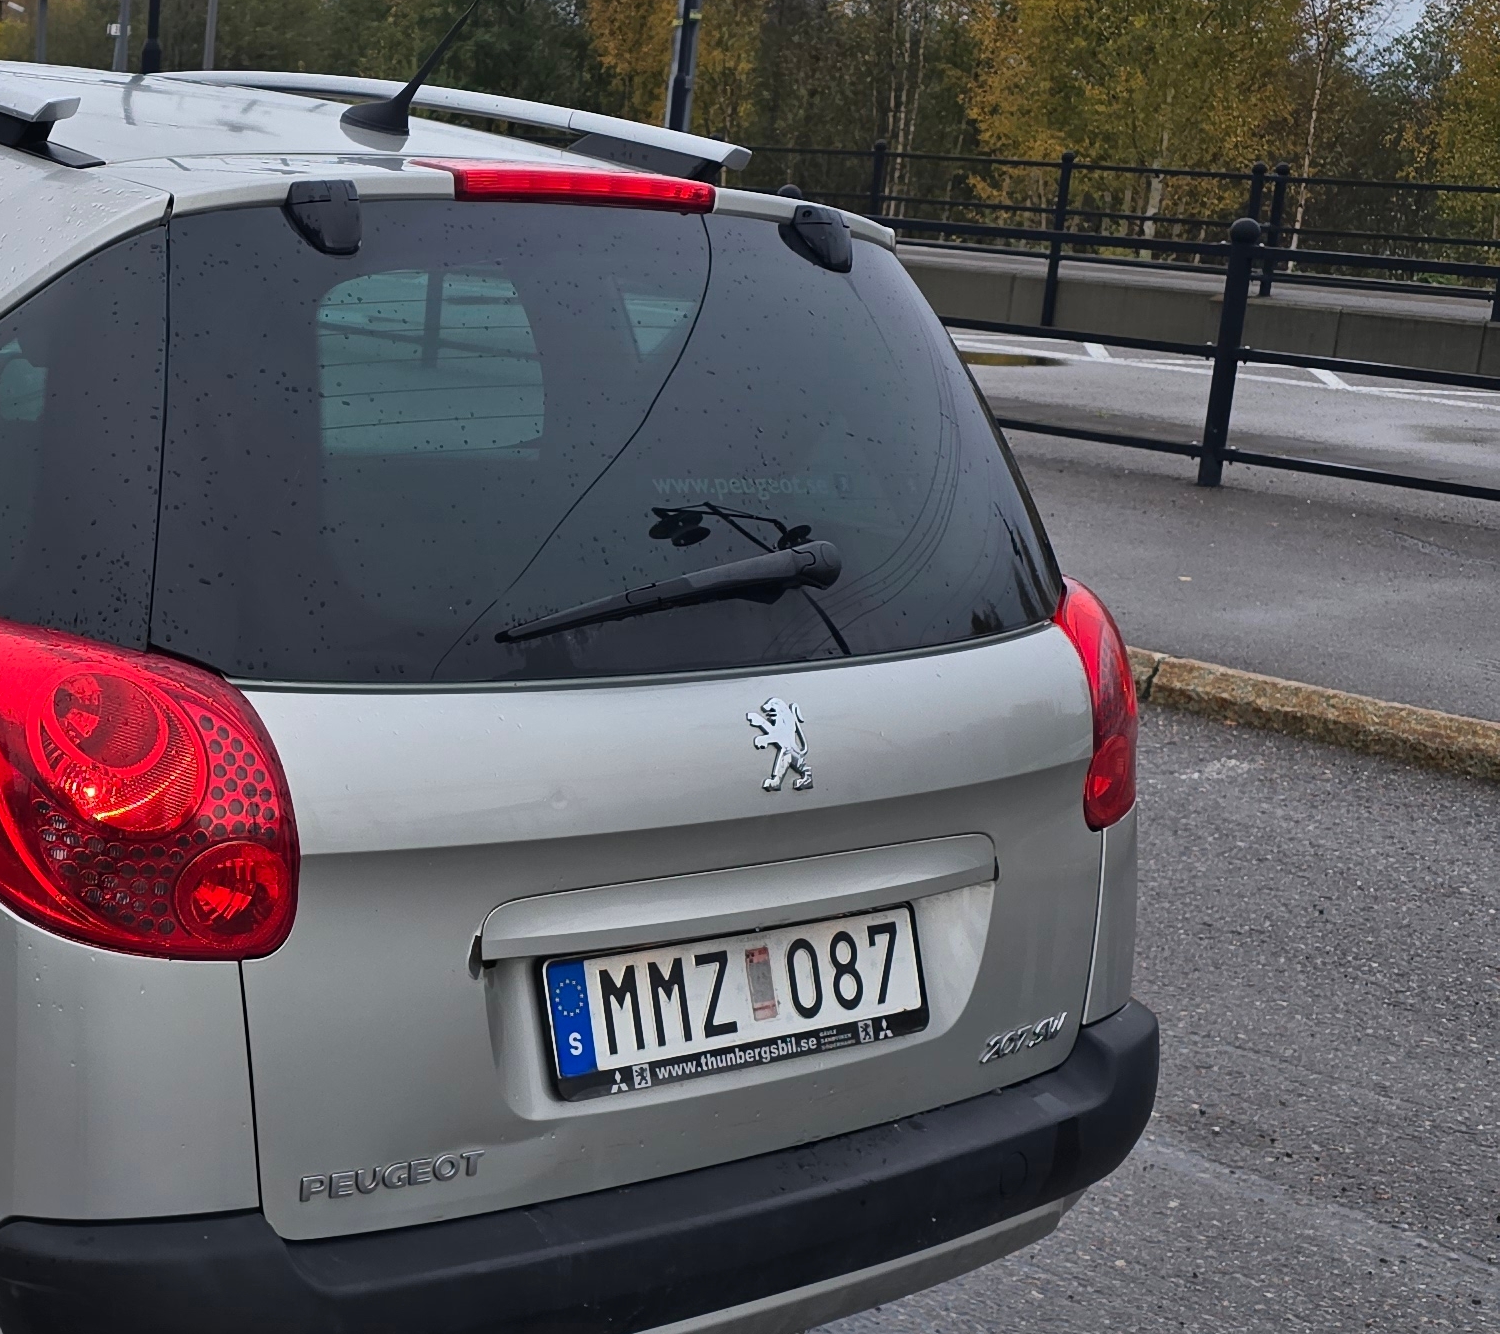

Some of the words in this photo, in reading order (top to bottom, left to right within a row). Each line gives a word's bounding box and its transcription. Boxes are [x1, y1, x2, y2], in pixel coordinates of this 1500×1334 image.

[597, 950, 739, 1057] MMZ
[785, 921, 898, 1020] 087
[568, 1031, 583, 1056] S
[655, 1036, 818, 1080] www.thunbergsbil.se
[299, 1149, 486, 1203] PEUGEOT
